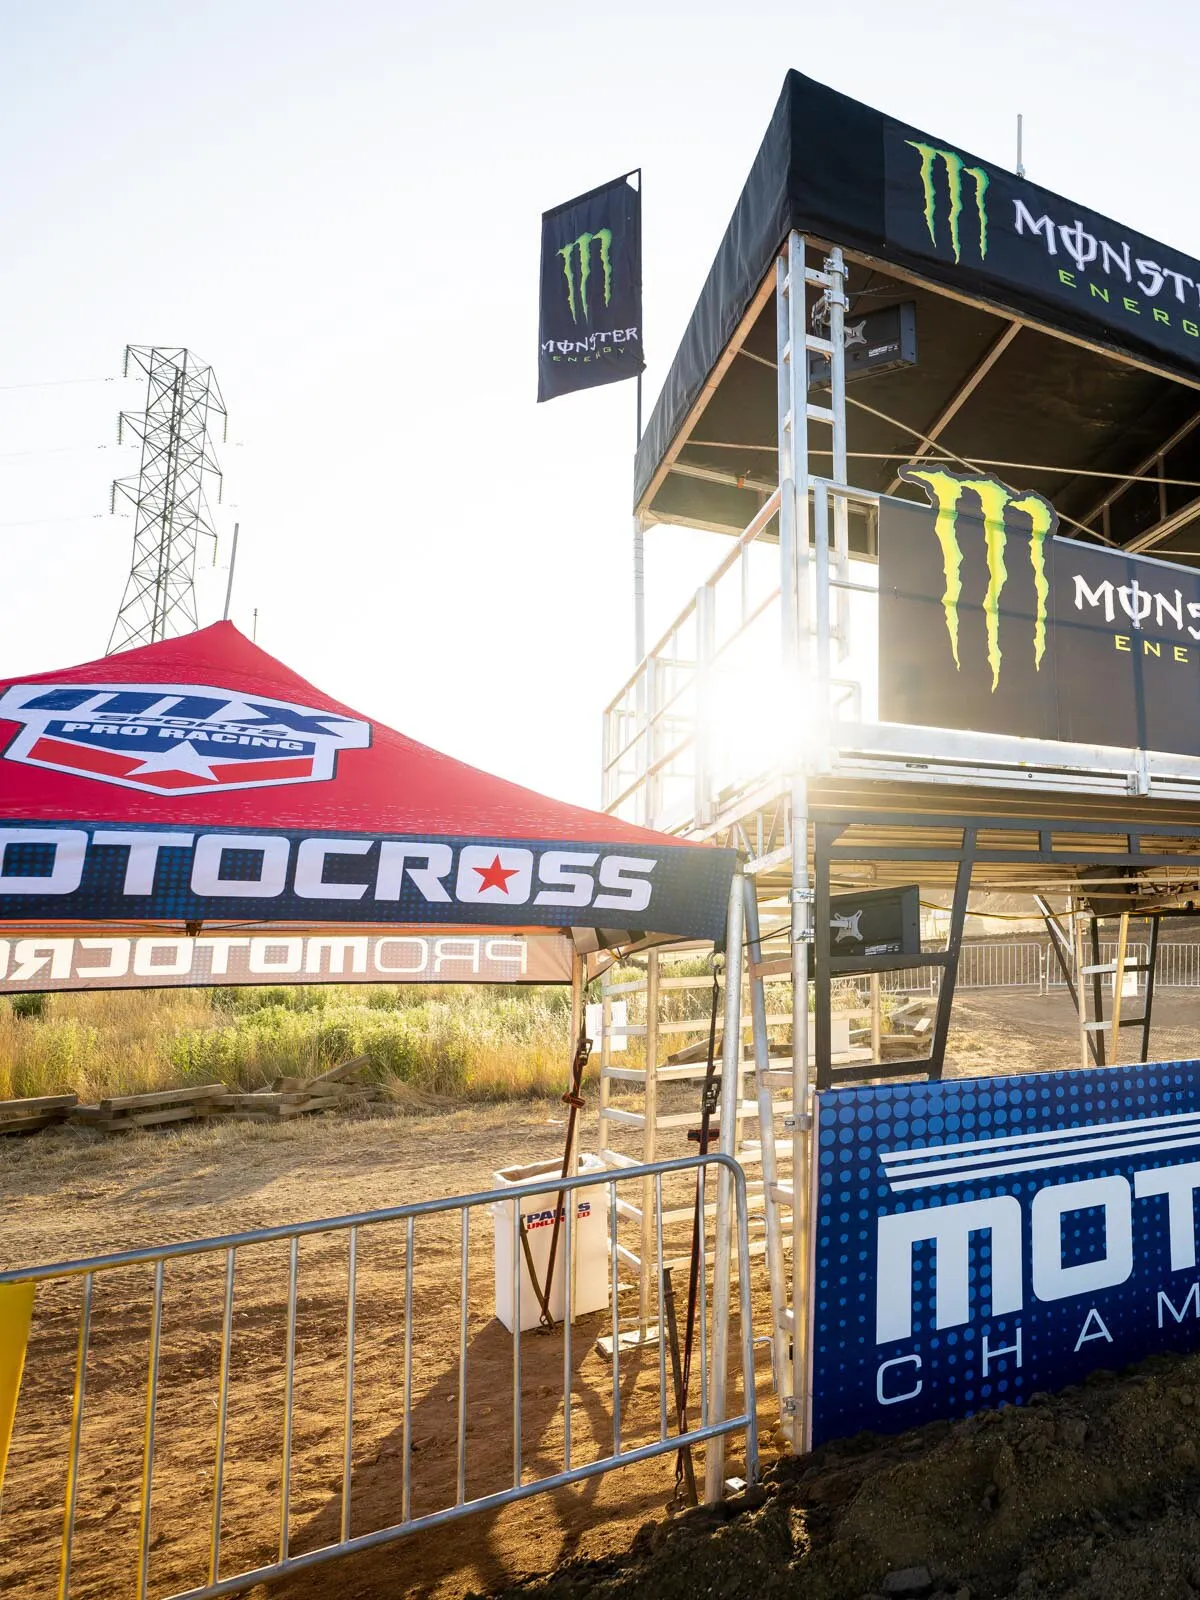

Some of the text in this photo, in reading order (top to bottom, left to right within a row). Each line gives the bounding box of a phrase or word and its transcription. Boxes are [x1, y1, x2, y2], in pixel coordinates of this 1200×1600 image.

[552, 346, 625, 362] ENERGY
[61, 721, 304, 751] PRO RACING
[93, 714, 289, 737] SPORTS
[526, 1202, 591, 1223] PAS
